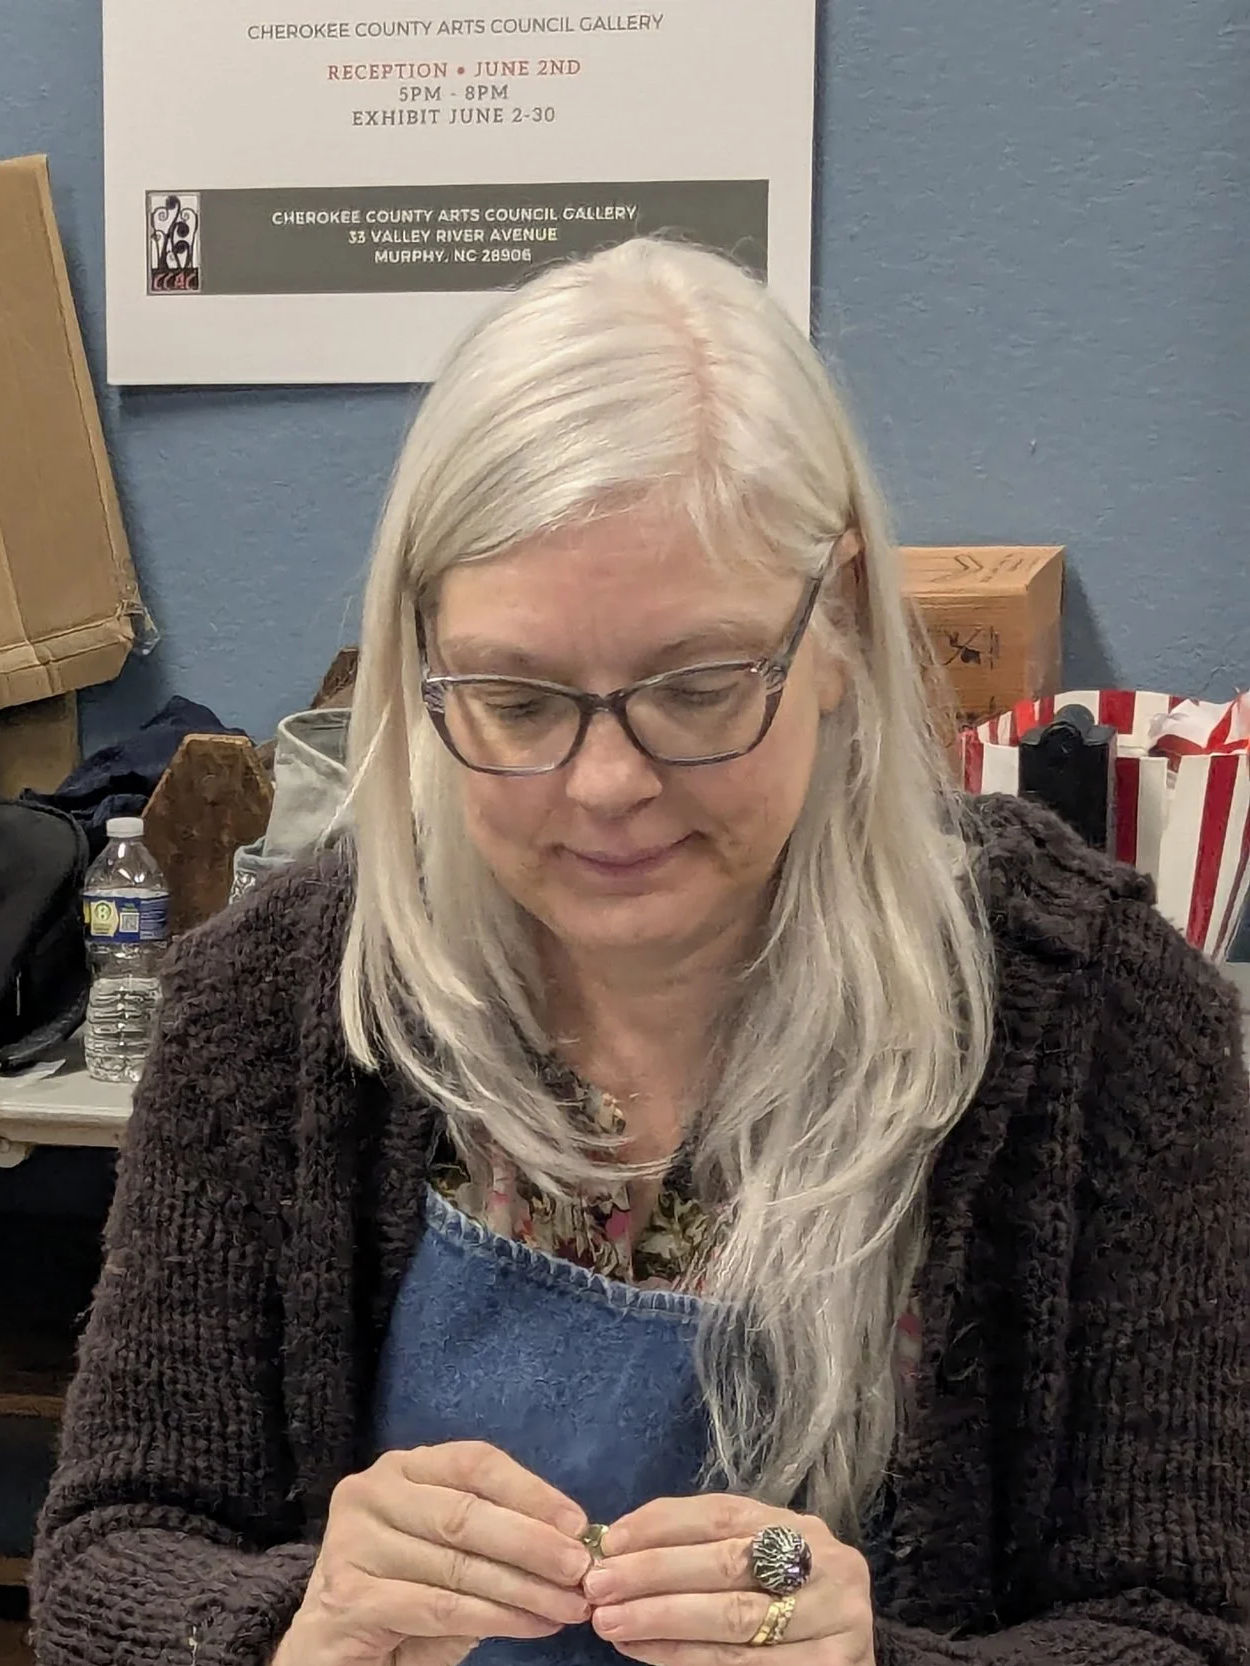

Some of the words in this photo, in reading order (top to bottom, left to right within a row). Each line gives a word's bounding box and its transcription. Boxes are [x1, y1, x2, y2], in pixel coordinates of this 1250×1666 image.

[248, 22, 350, 40] CHEROKEE
[355, 21, 432, 38] COUNTY
[437, 19, 485, 36] ARTS
[491, 17, 574, 34] COUNCIL
[580, 14, 663, 32] GALLERY
[327, 63, 448, 81] RECEPTION
[474, 61, 529, 77] JUNE
[537, 59, 581, 76] 2ND
[399, 86, 441, 102] 5PM
[465, 84, 508, 101] 8PM
[352, 109, 440, 126] EXHIBIT
[449, 108, 503, 124] JUNE
[512, 107, 556, 123] 2-30
[272, 209, 360, 225] CHEROKEE
[366, 209, 433, 223] COUNTY
[438, 208, 480, 222] ARTS
[485, 207, 557, 221] COUNCIL
[563, 205, 637, 221] GALLERY
[348, 230, 366, 244] 33
[371, 229, 431, 243] VALLEY
[436, 229, 485, 242] RIVER
[490, 228, 558, 242] AVENUE
[374, 249, 448, 264] MURPHY,
[454, 249, 478, 262] NC
